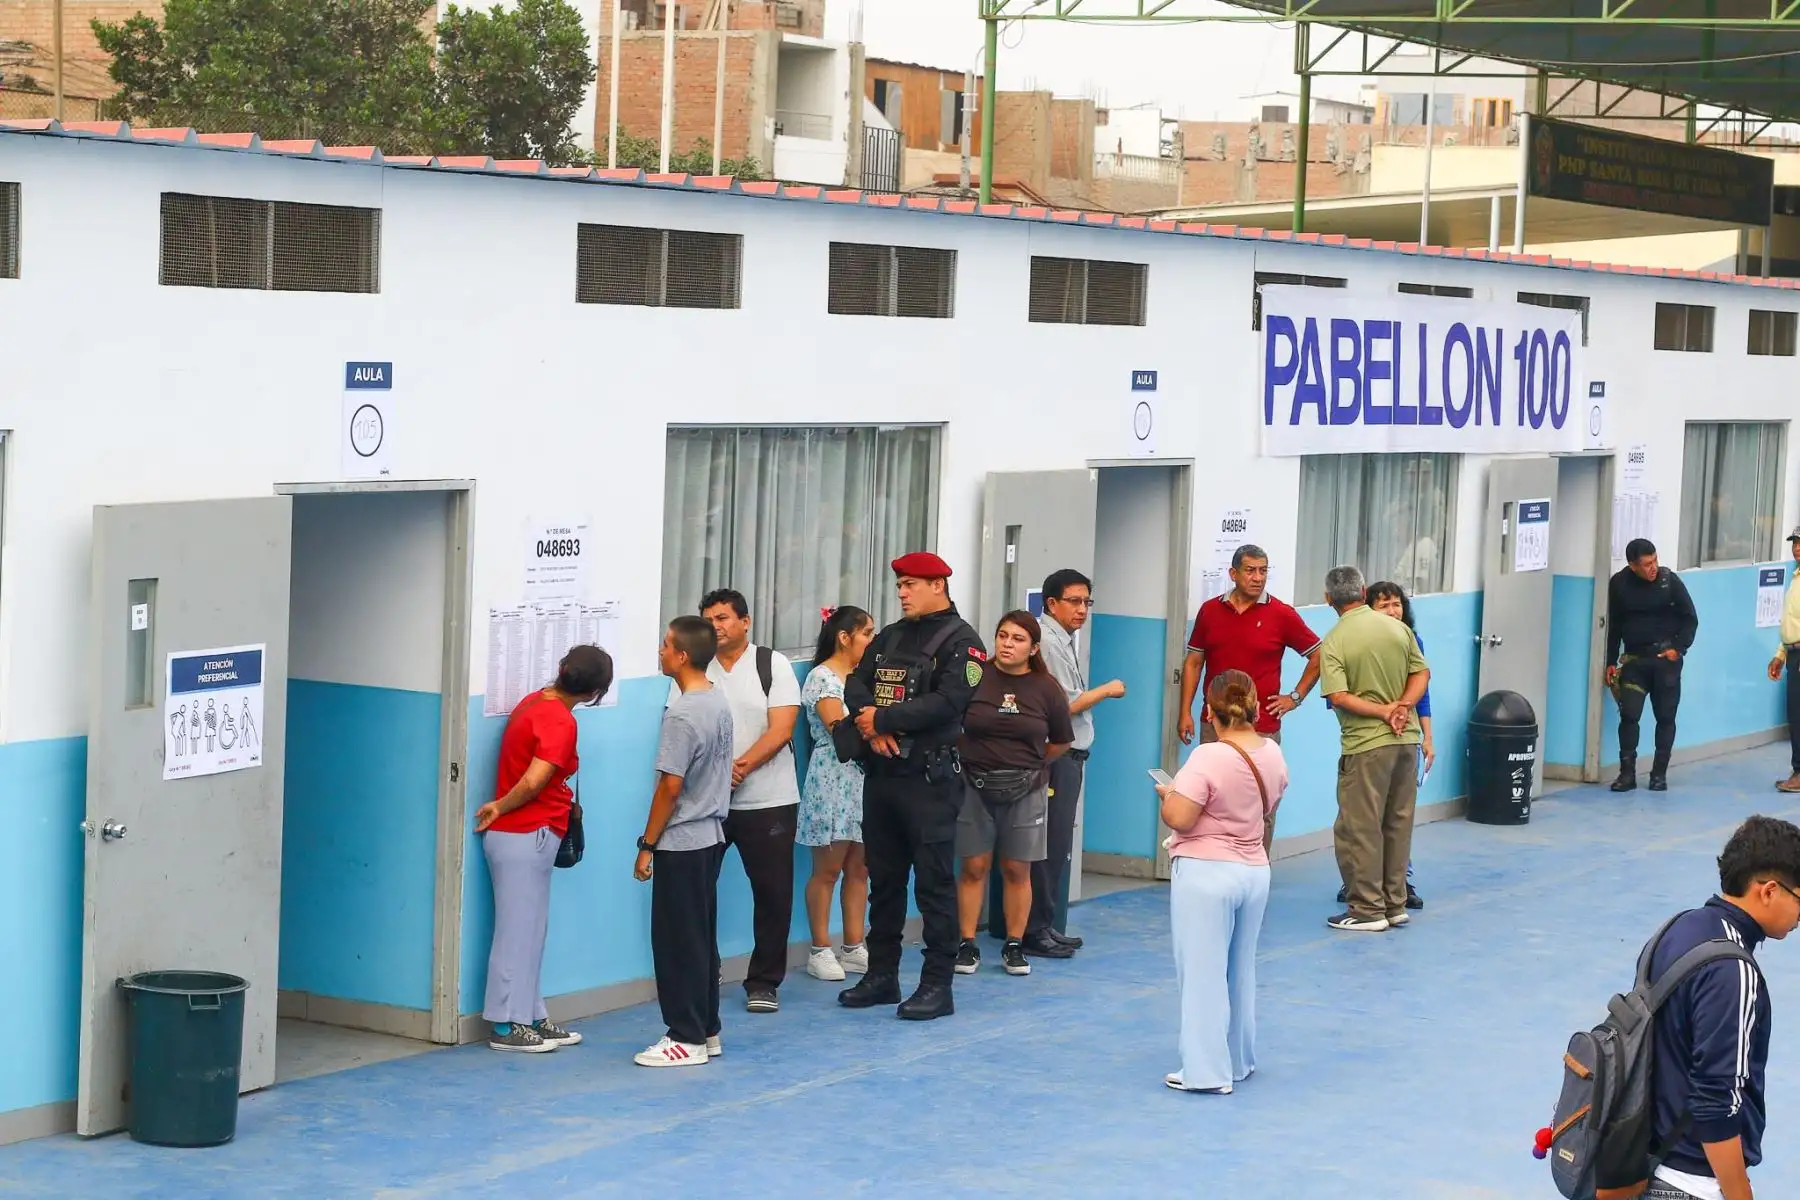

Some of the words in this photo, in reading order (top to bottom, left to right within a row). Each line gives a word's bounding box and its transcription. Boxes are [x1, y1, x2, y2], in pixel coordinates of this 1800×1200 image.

[1590, 161, 1632, 183] SANTA
[354, 368, 384, 381] AULA
[1264, 315, 1503, 429] PABELLON
[1514, 328, 1571, 430] 100
[1136, 374, 1153, 385] AULA
[1222, 519, 1247, 533] 048694
[536, 538, 580, 558] 048693
[203, 658, 234, 671] ATENCIÓN
[197, 671, 239, 684] PREFERENCIAL
